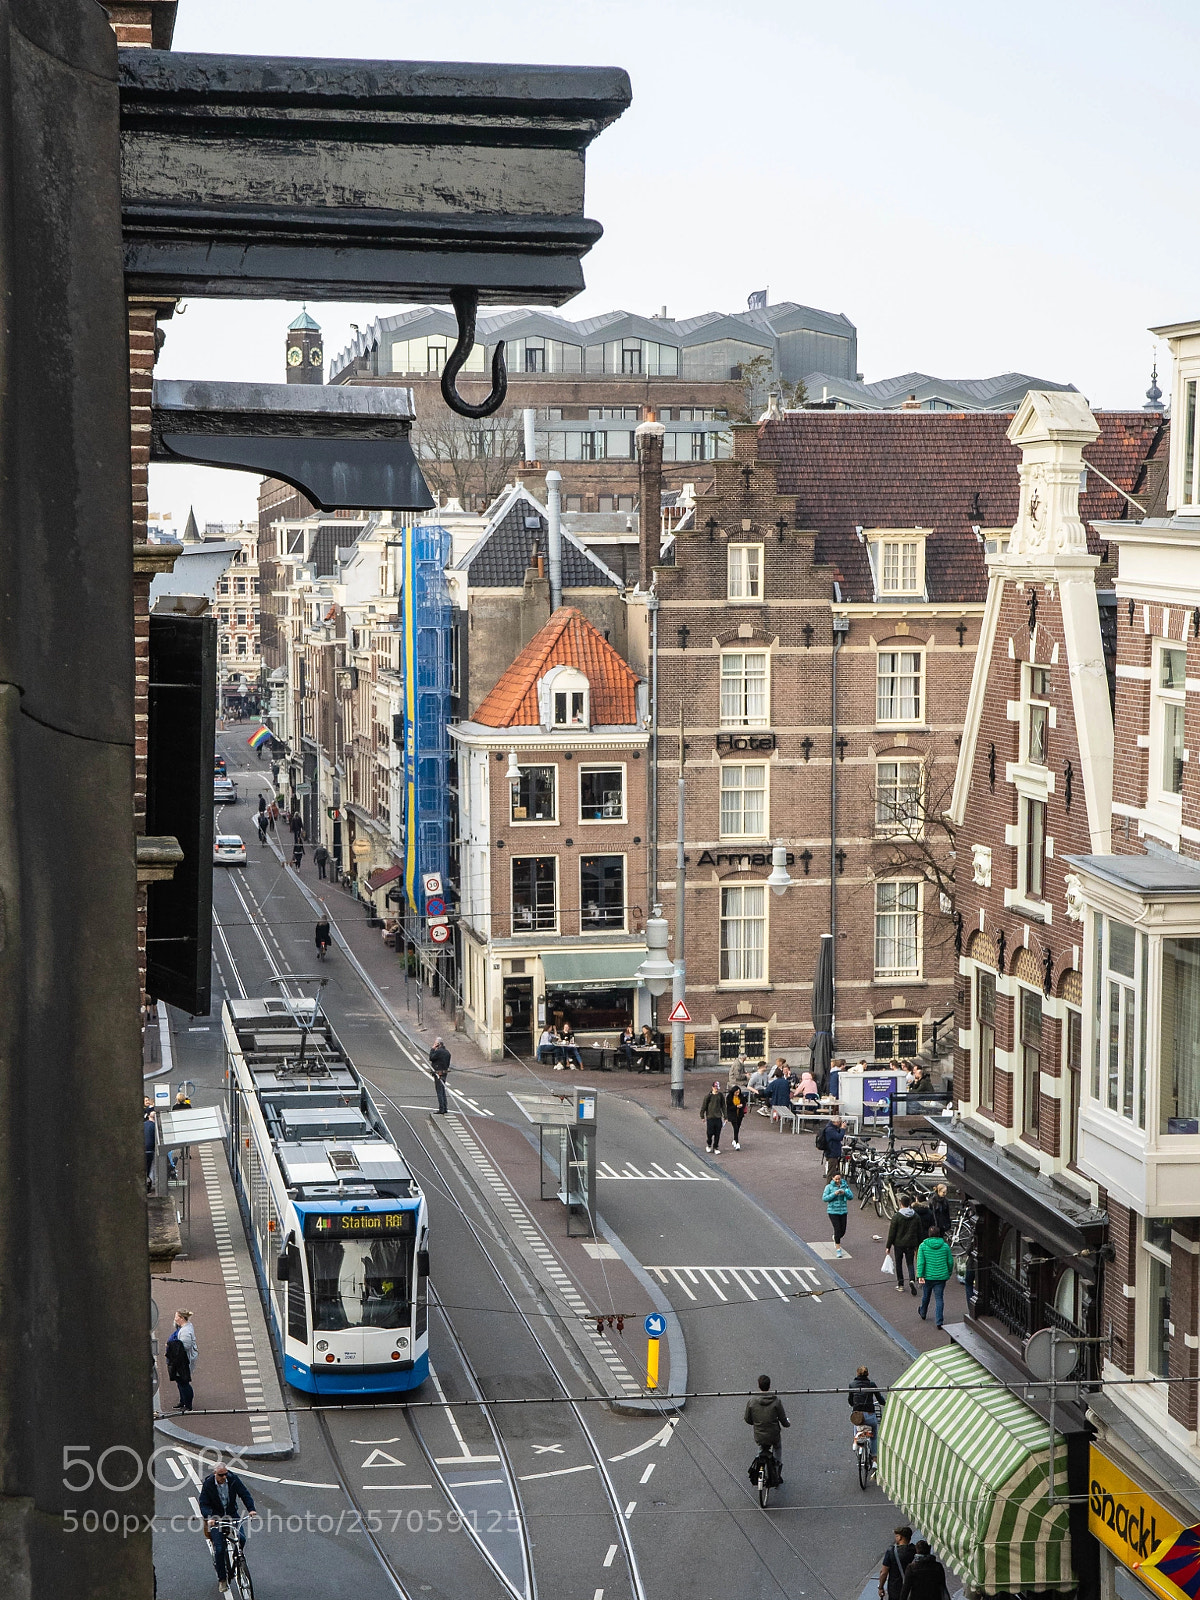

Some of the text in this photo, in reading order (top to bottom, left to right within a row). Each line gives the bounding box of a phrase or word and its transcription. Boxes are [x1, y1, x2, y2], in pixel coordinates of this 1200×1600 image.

[716, 733, 776, 750] Hotel
[315, 1216, 323, 1232] 4
[341, 1215, 381, 1229] Station
